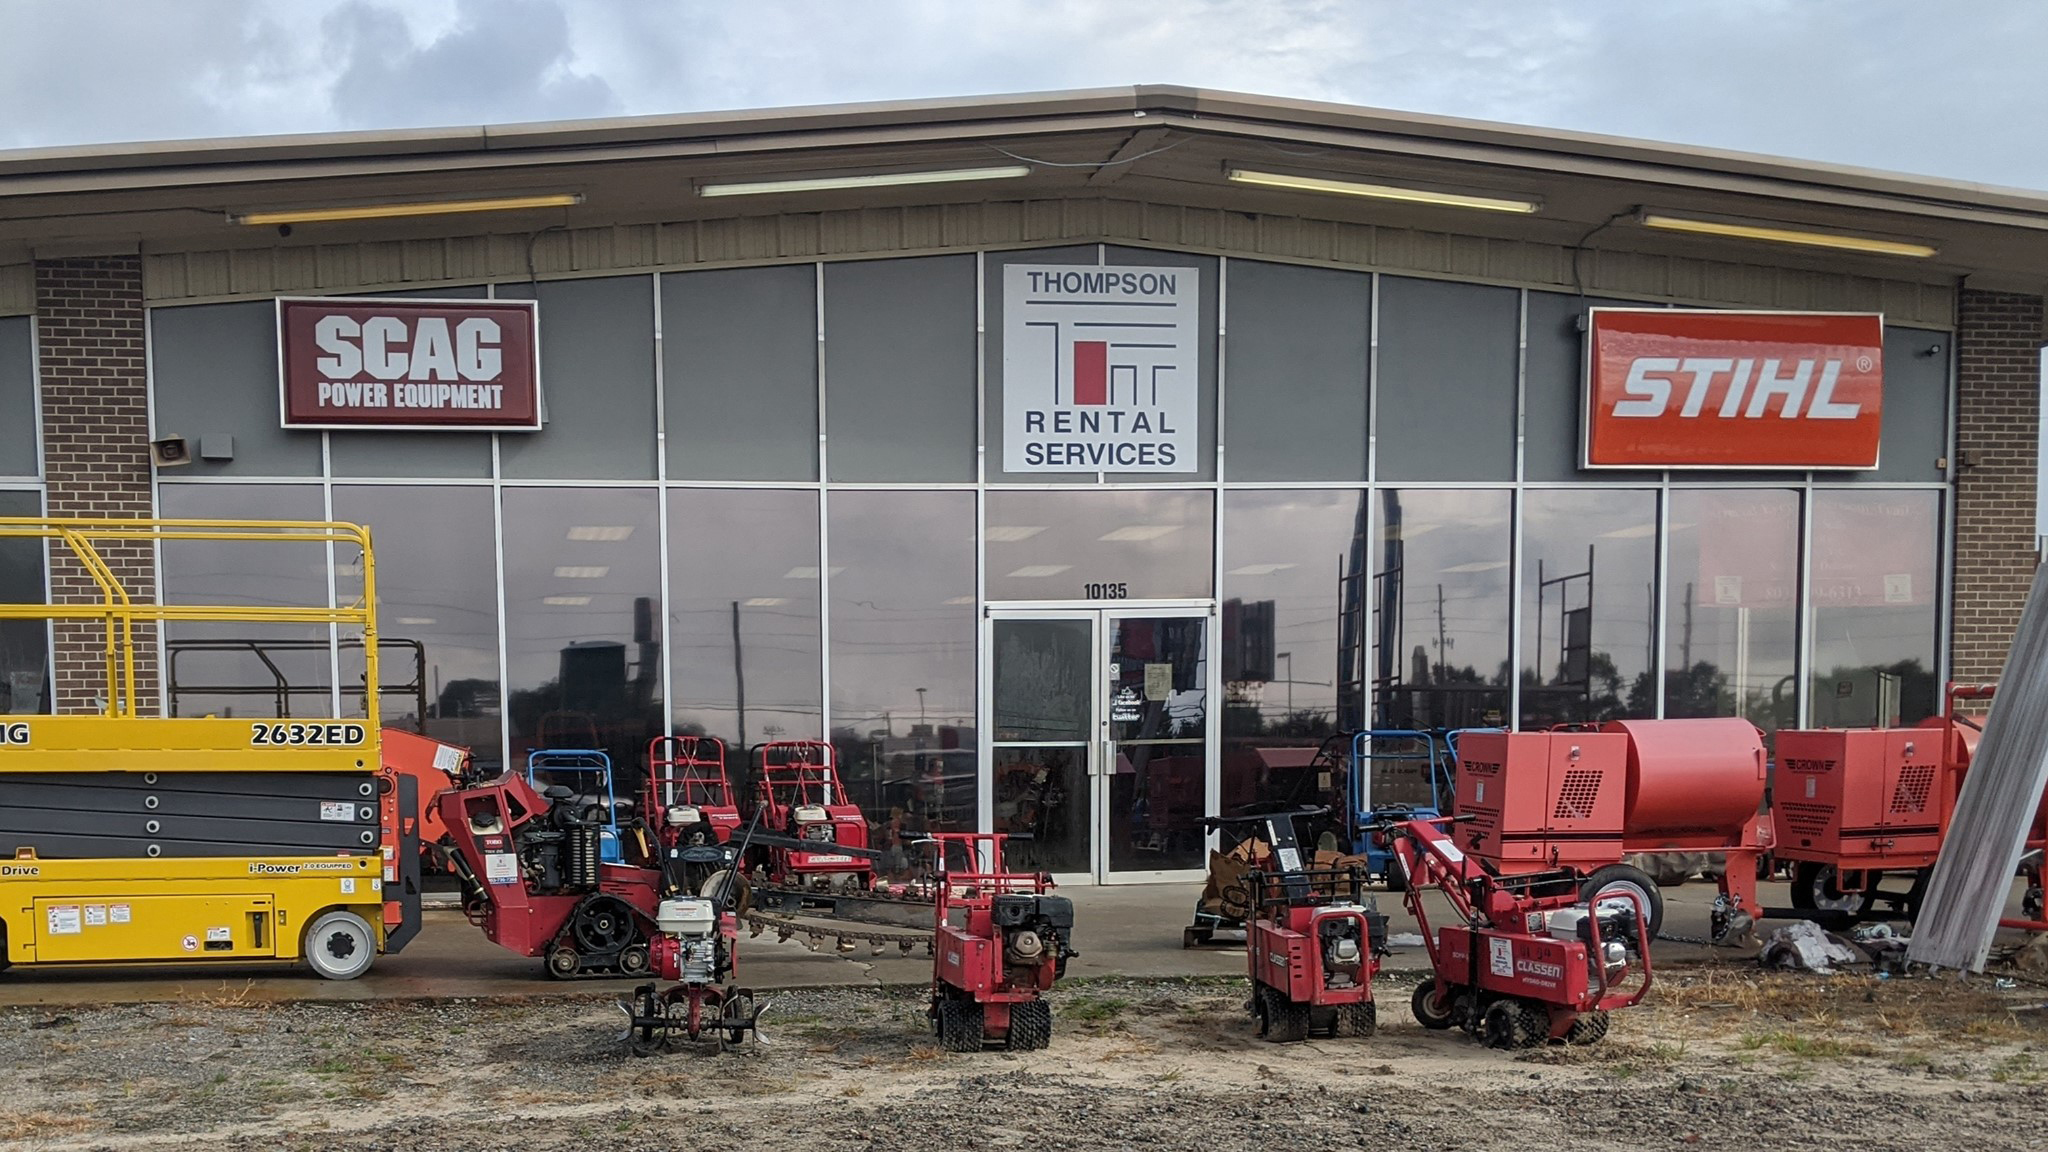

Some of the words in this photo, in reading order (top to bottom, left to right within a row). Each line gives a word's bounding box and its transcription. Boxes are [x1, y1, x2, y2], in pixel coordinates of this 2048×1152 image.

[1027, 271, 1176, 295] THOMPSON
[315, 315, 502, 381] SCAG
[318, 382, 388, 408] POWER
[394, 383, 503, 409] EQUIPMENT
[1611, 357, 1862, 419] STIHL
[1025, 410, 1176, 434] RENTAL
[1025, 442, 1176, 466] SERVICES
[1084, 583, 1127, 599] 10135
[251, 723, 365, 746] 2632ED
[1795, 759, 1825, 770] CROWN
[1, 865, 39, 876] Drive
[248, 863, 301, 874] i-Power
[1516, 960, 1560, 978] CLASSEN
